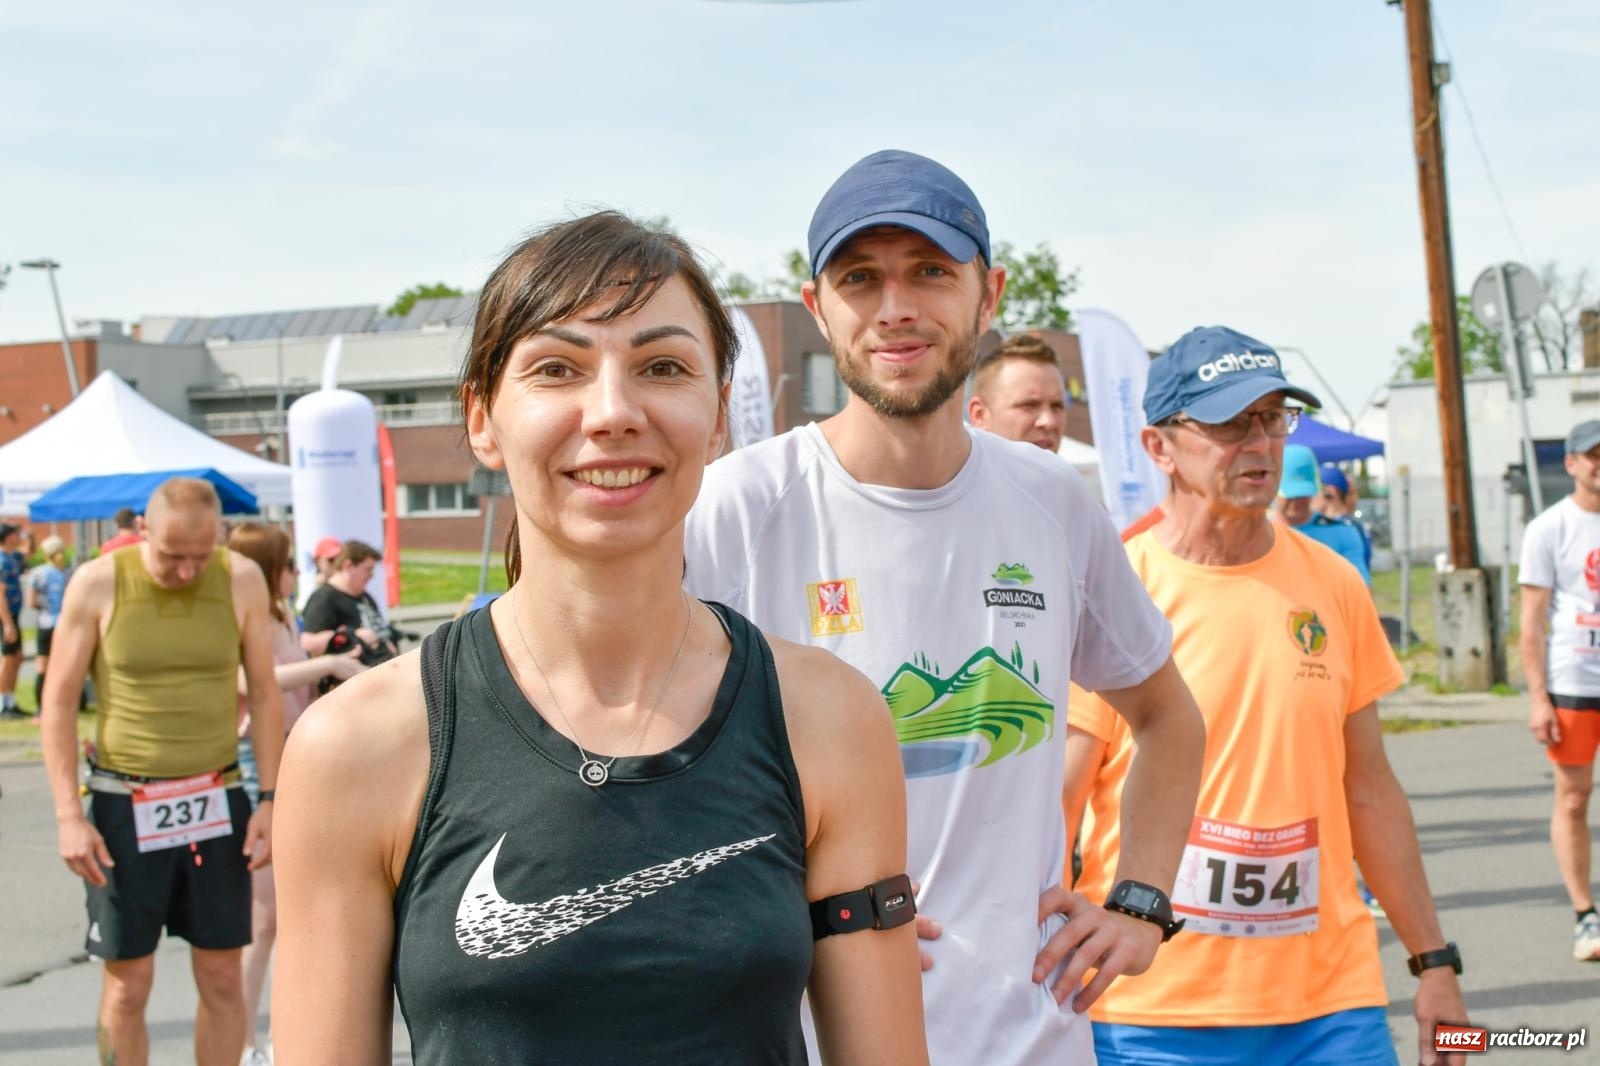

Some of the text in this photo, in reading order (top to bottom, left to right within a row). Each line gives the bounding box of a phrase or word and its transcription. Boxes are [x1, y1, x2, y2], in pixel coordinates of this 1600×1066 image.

[987, 590, 1044, 607] GONIACKA
[1589, 629, 1600, 647] 1
[155, 796, 209, 830] 237
[1200, 821, 1223, 835] XVI
[1253, 831, 1275, 842] BEZ
[1207, 857, 1300, 907] 154
